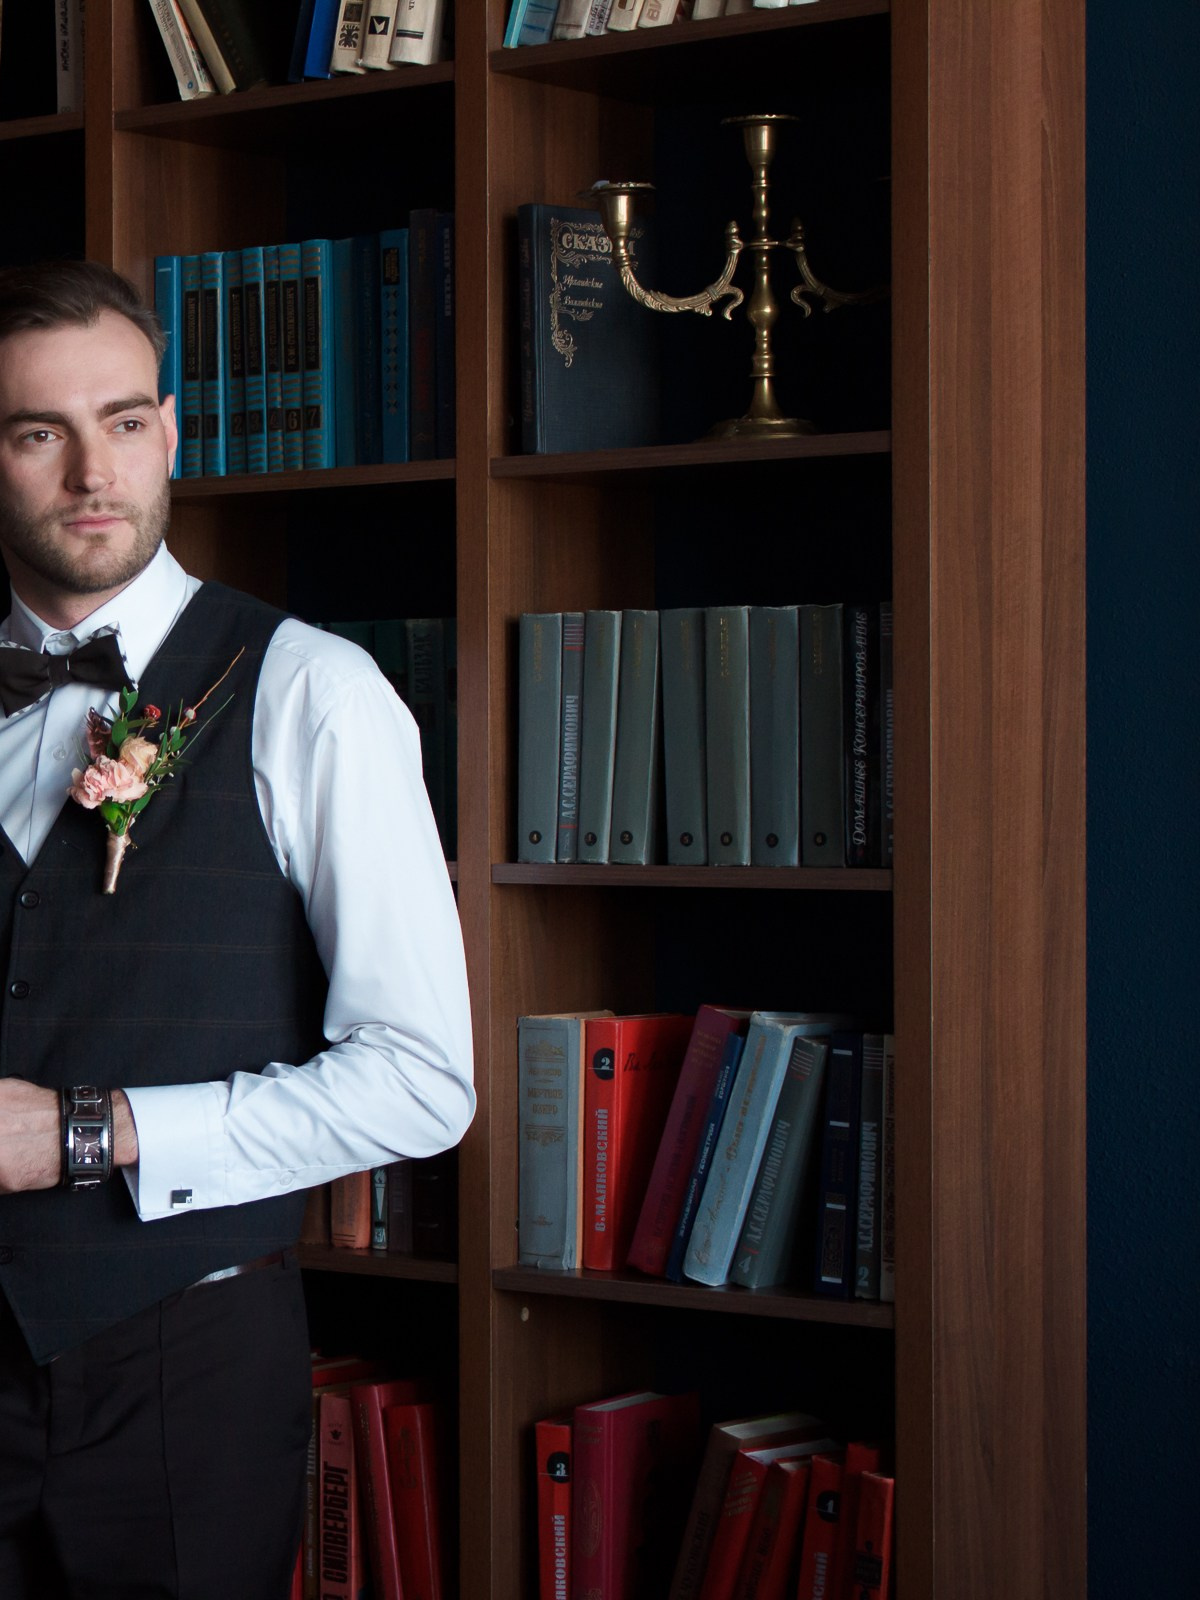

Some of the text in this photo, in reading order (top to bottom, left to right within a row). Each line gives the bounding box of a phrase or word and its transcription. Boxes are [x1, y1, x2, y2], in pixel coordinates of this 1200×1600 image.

[288, 412, 297, 428] 6
[309, 409, 316, 425] 7
[561, 694, 578, 819] А.С.СЕРАФИМОВИЧ
[601, 1058, 610, 1069] 2
[698, 1123, 715, 1174] ГЕОМЕТРИЯ
[595, 1108, 608, 1232] В.МАЯКОВСКИЙ
[858, 1121, 877, 1252] А.С.СЕРАФИМОВИЧ
[858, 1266, 869, 1286] 2
[555, 1461, 567, 1477] 3
[322, 1460, 348, 1584] СИЛВЕРБЕРГ
